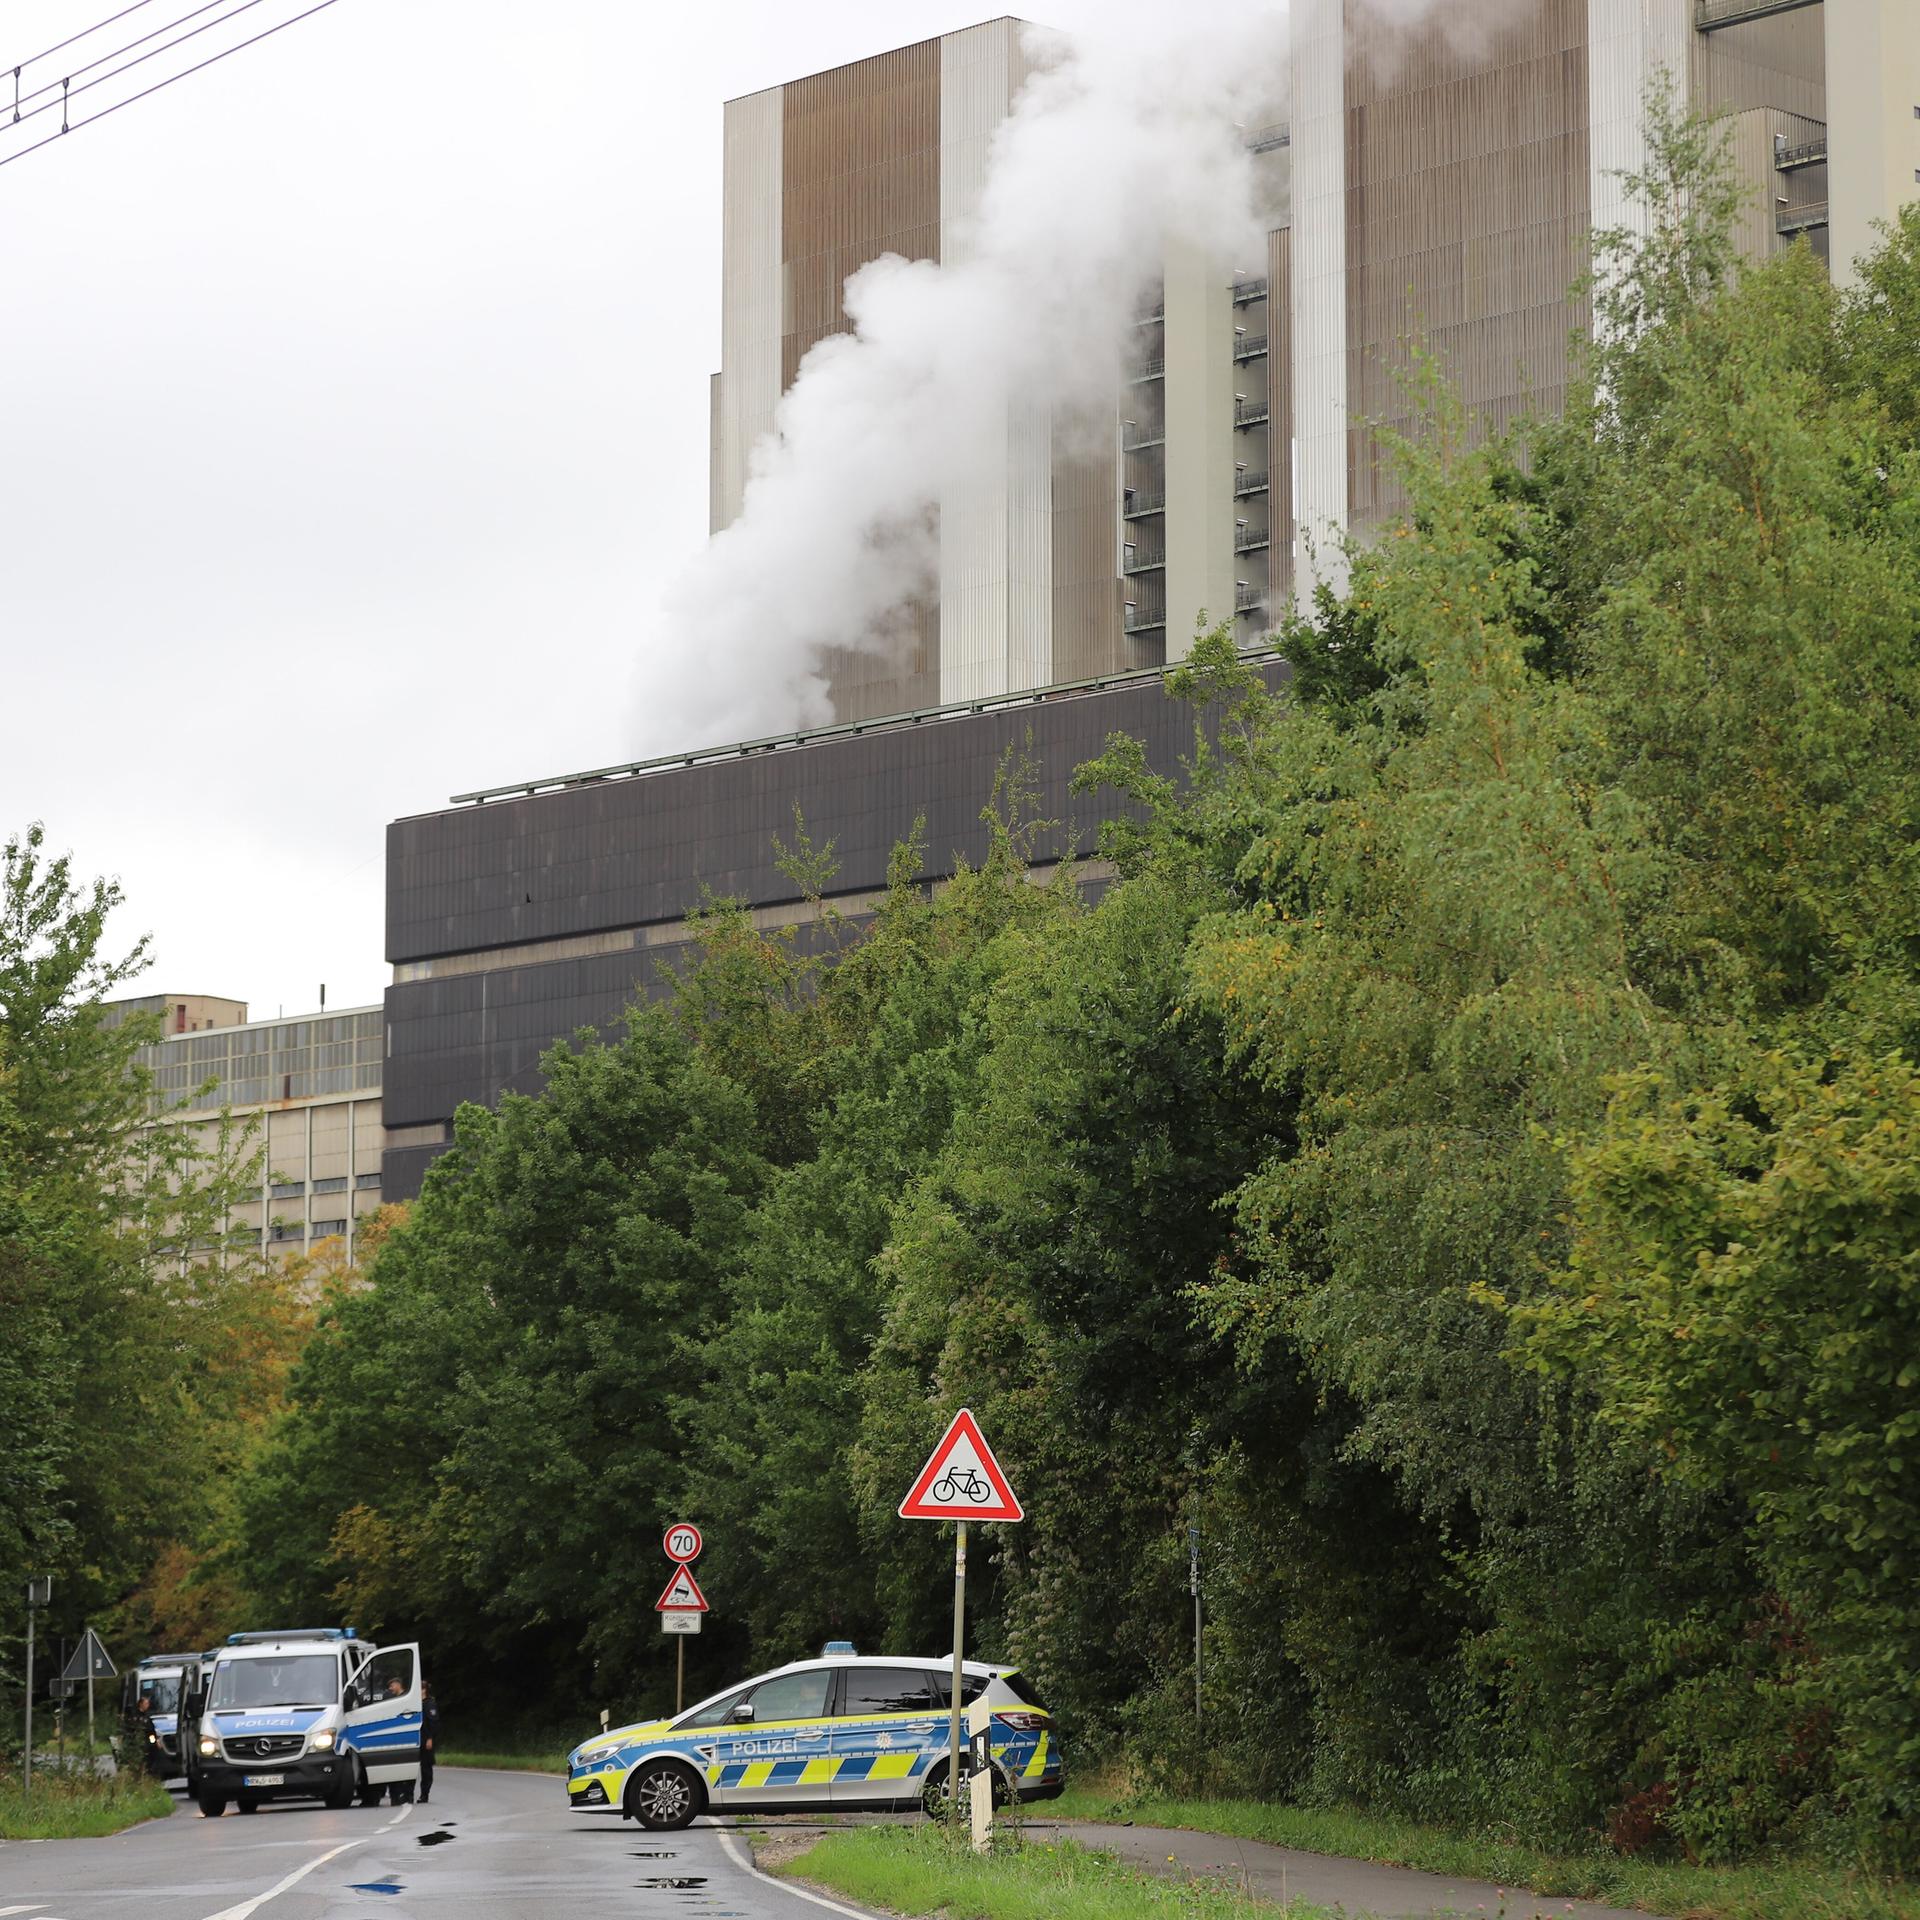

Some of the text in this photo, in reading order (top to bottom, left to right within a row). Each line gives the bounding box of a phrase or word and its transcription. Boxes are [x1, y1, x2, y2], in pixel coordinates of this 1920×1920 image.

[673, 1535, 693, 1552] 70
[235, 1719, 294, 1728] POLIZEI
[732, 1739, 797, 1756] POLIZEI
